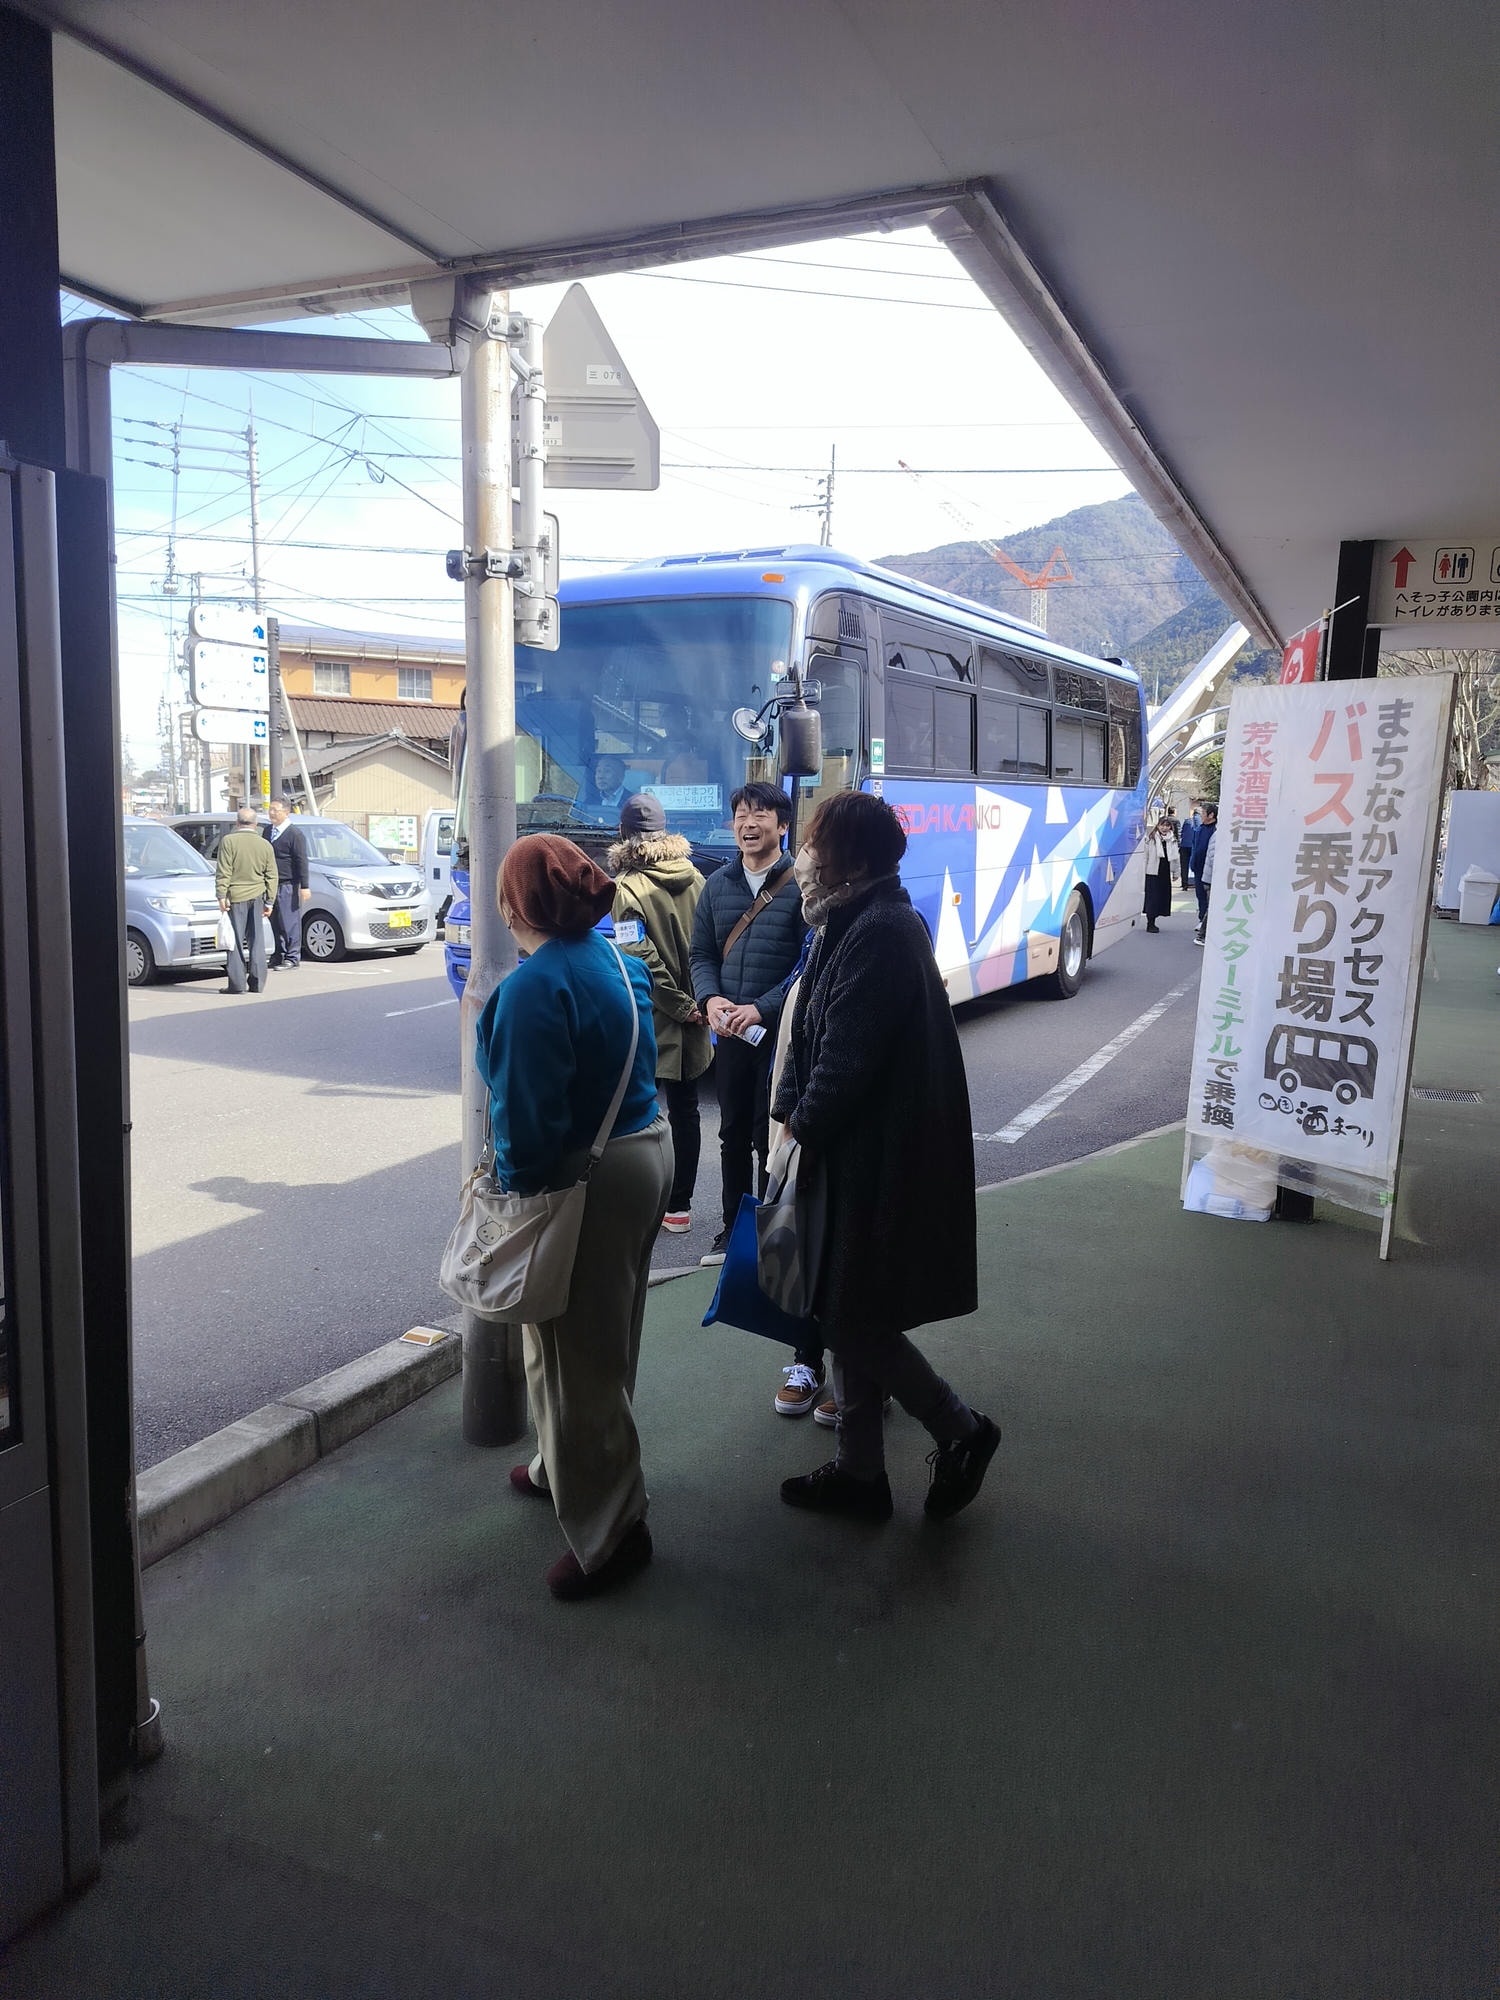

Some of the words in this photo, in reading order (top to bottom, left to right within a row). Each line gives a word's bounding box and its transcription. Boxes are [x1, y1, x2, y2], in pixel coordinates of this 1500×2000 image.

[1201, 721, 1279, 1131] 芳水酒造行きはバスターミナルで乗換
[1275, 701, 1368, 1023] バス乗り場
[1339, 698, 1414, 1028] まちなかアクセス
